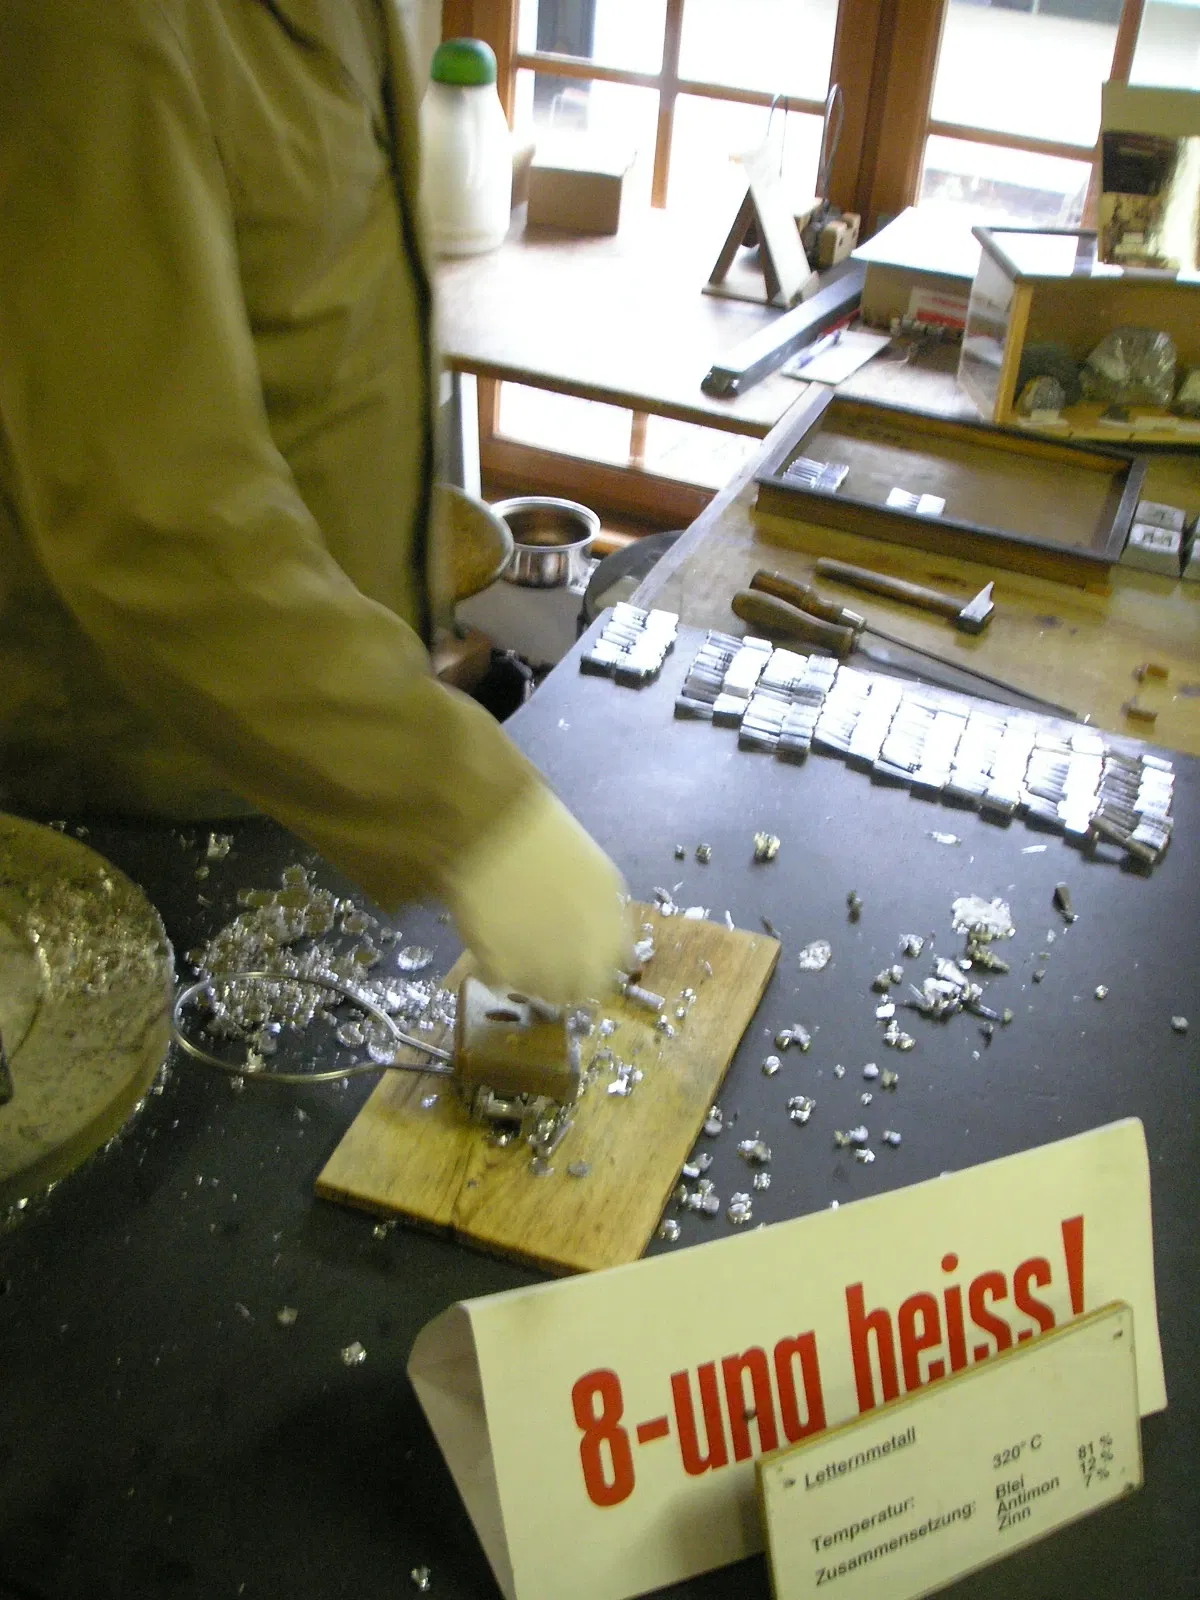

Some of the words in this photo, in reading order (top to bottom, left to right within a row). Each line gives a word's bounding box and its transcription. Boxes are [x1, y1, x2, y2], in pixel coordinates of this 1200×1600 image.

[845, 1215, 1085, 1415] heiss!
[804, 1425, 917, 1490] Letternmetall
[812, 1497, 915, 1553] Temperatur:
[998, 1476, 1060, 1517] Antimon
[998, 1506, 1031, 1532] Zinn
[815, 1501, 976, 1587] Zusammensetzung:
[996, 1474, 1024, 1500] Blei
